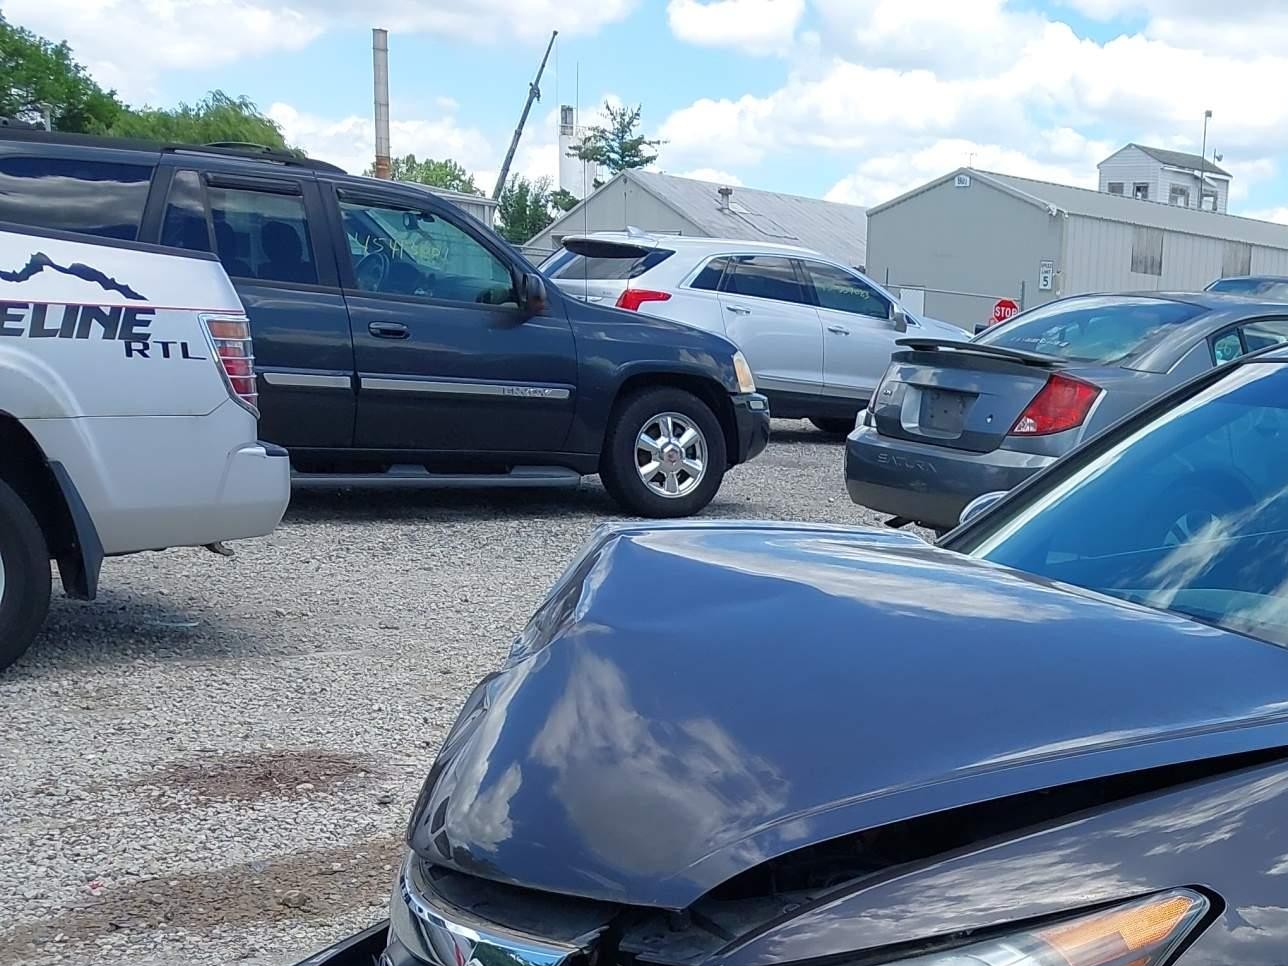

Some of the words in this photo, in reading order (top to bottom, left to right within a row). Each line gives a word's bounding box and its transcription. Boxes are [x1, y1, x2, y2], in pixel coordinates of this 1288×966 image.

[1042, 275, 1049, 287] 5
[994, 306, 1018, 318] STOP
[124, 339, 208, 361] RTL
